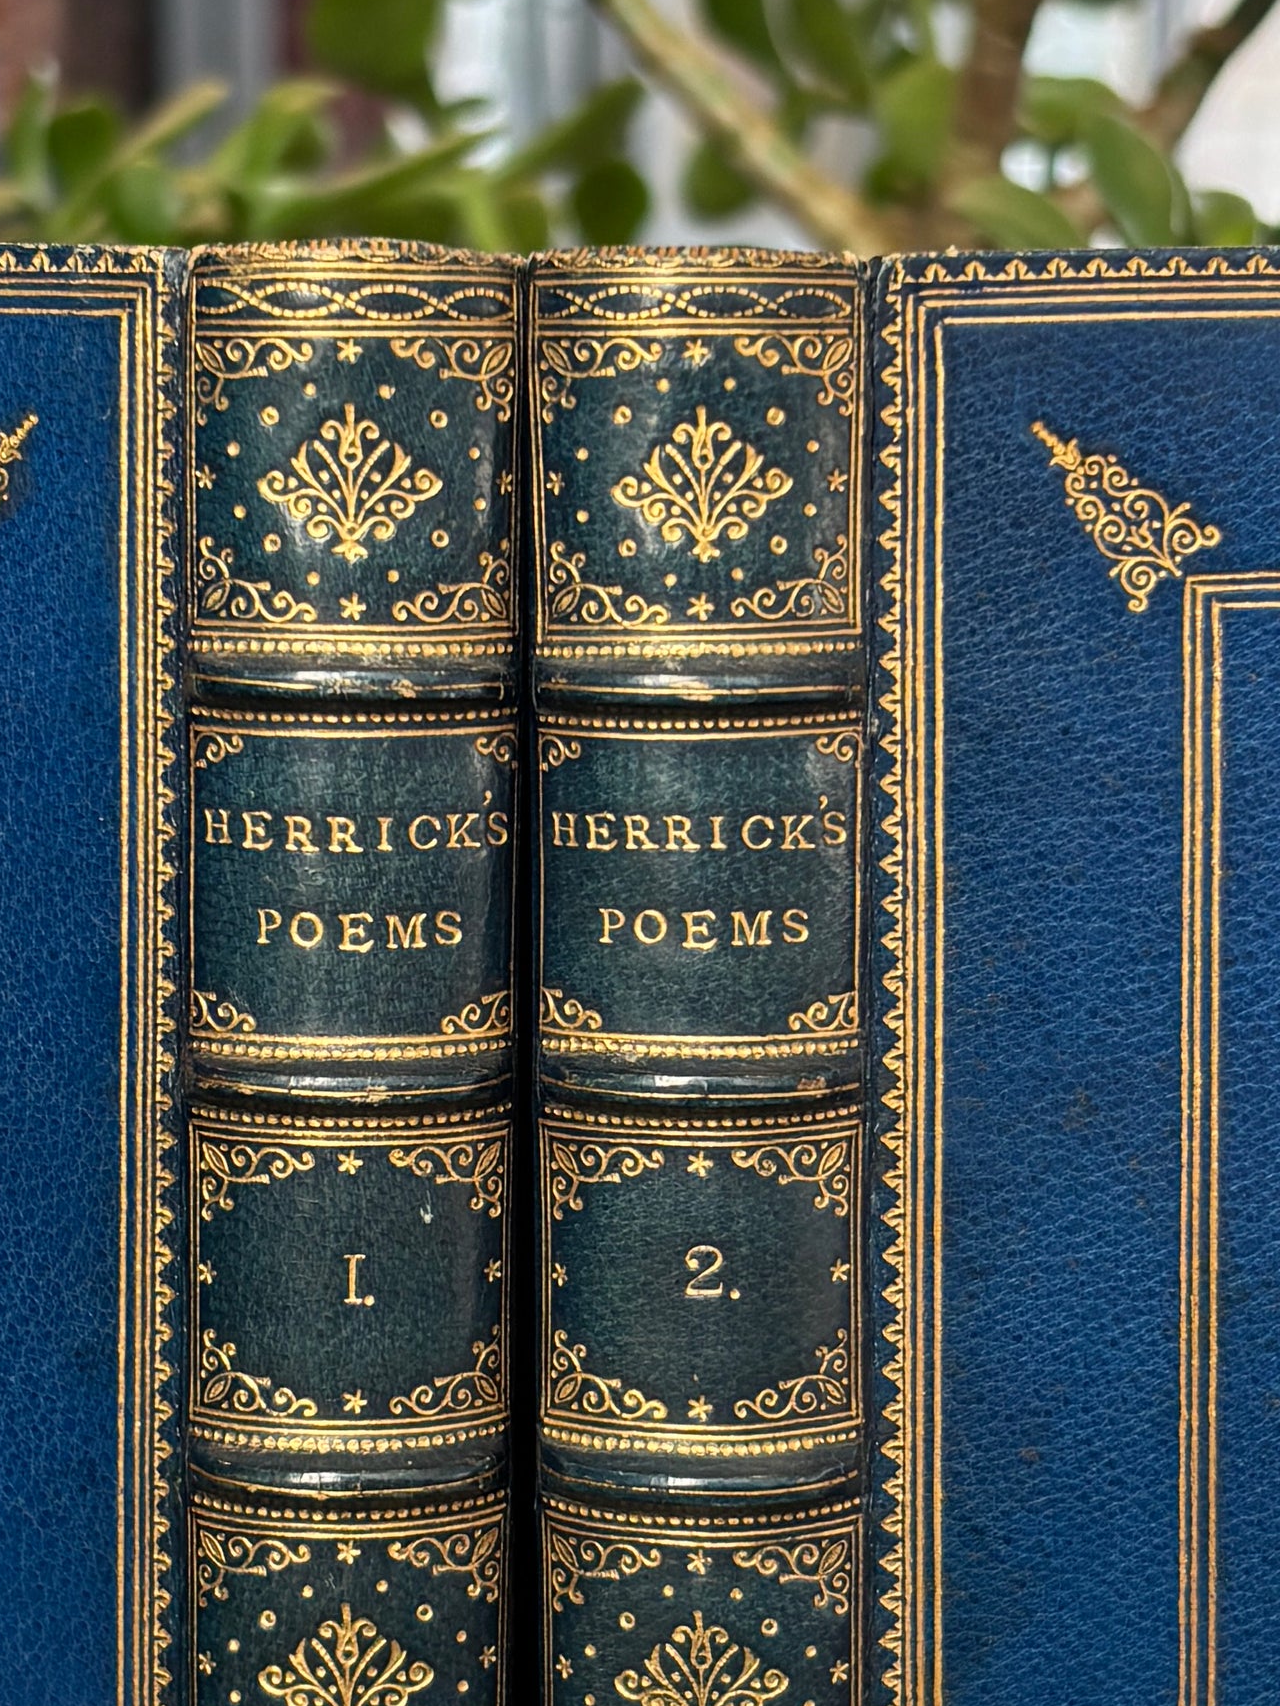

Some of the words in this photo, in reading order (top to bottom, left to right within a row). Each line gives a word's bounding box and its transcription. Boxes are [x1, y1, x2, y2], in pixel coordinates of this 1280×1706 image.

[256, 908, 464, 954] POEMS
[598, 907, 811, 952] POEMS
[684, 1244, 741, 1299] 2.
